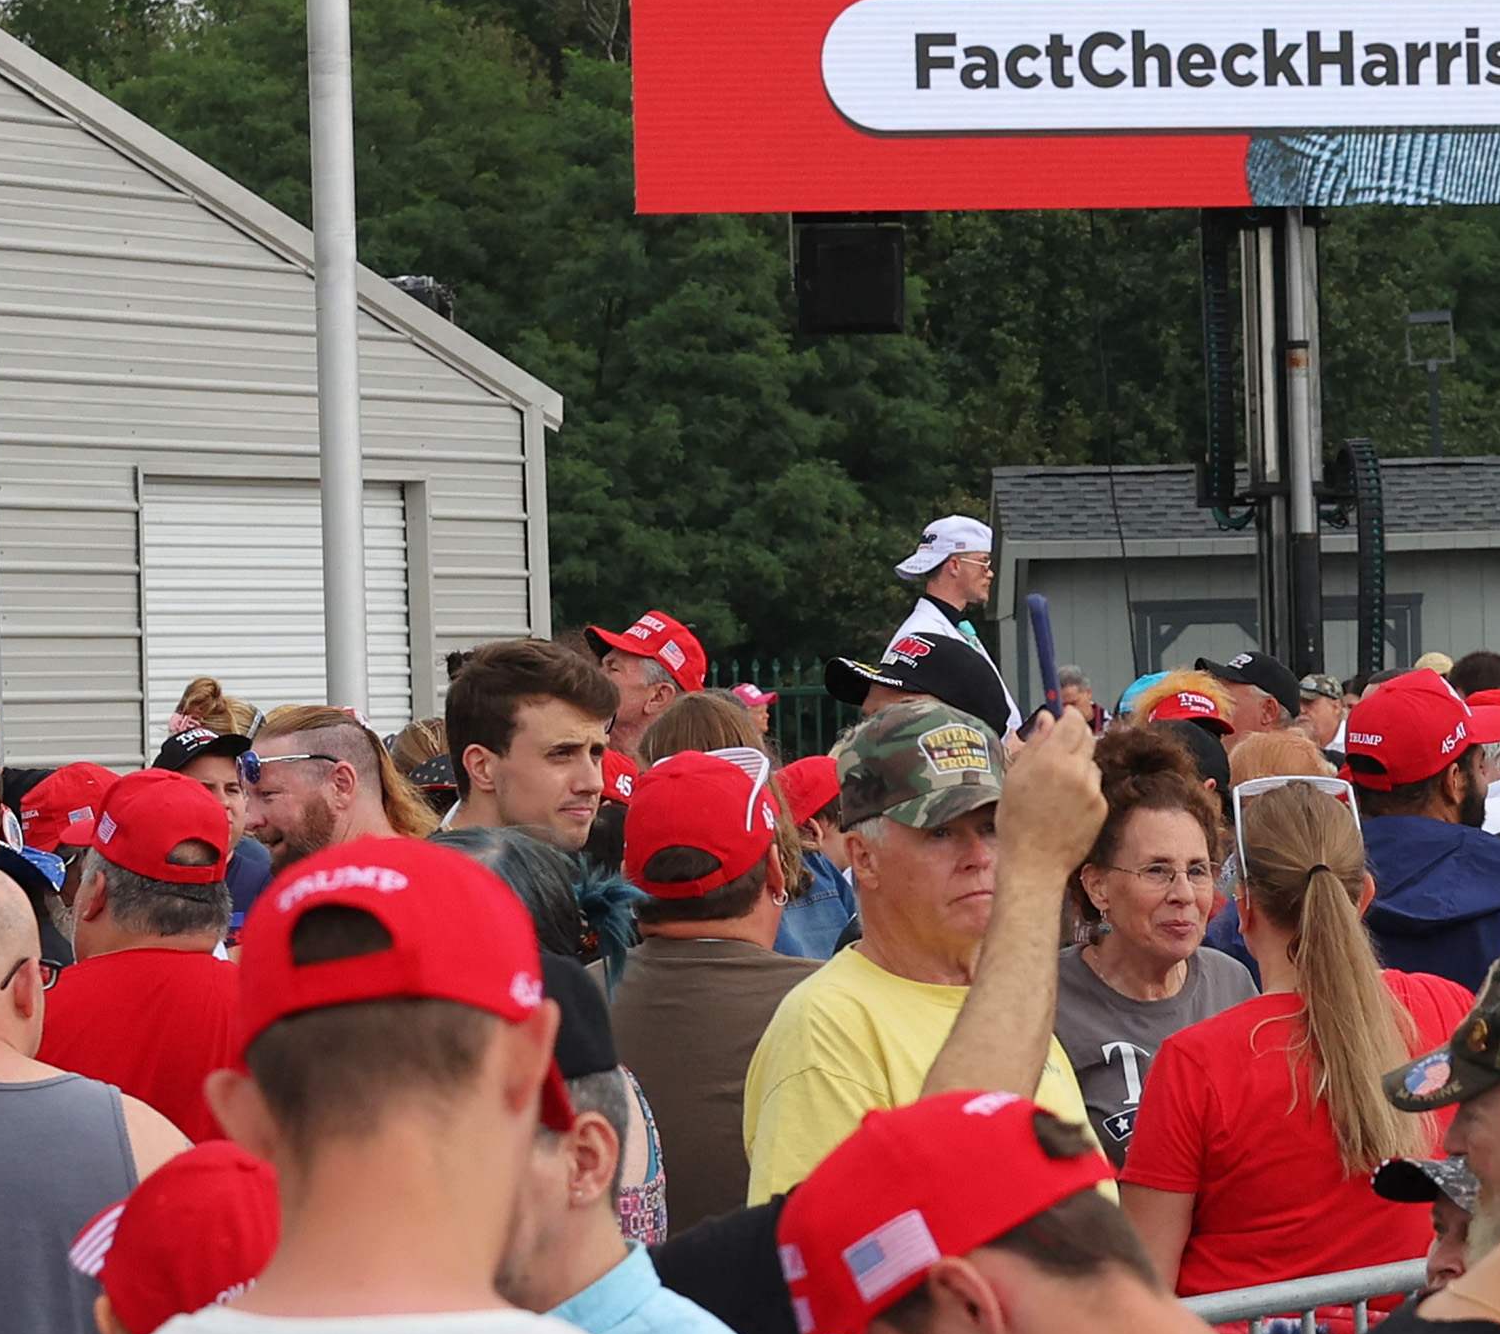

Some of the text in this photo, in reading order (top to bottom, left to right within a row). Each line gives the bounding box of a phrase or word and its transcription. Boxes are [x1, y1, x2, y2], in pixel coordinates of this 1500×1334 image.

[1349, 732, 1383, 746] TRUMP
[1441, 722, 1467, 754] 45-47
[936, 755, 987, 770] TRUMP
[615, 773, 633, 797] 45
[280, 865, 409, 913] TRUMP
